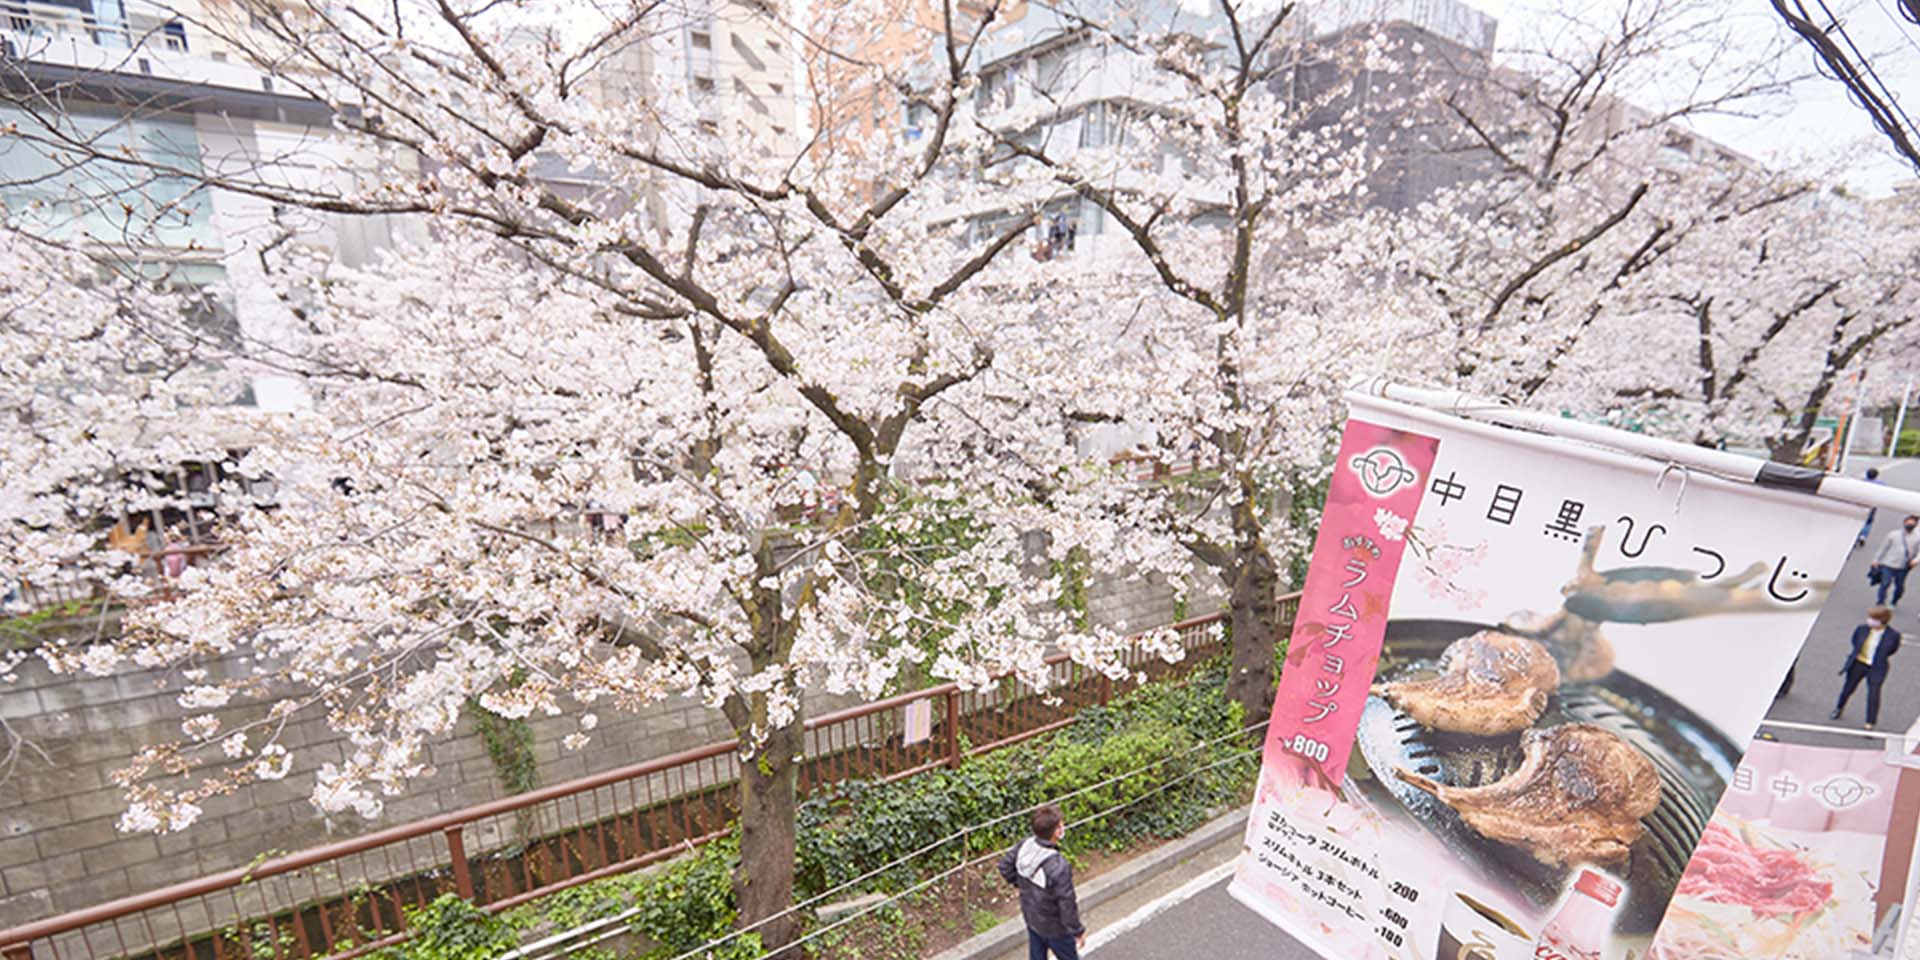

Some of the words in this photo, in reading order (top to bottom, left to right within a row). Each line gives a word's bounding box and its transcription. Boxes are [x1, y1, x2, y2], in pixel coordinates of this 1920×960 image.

[1430, 471, 1809, 602] 中目黒ひつじ
[1303, 559, 1368, 724] ラムチョップ
